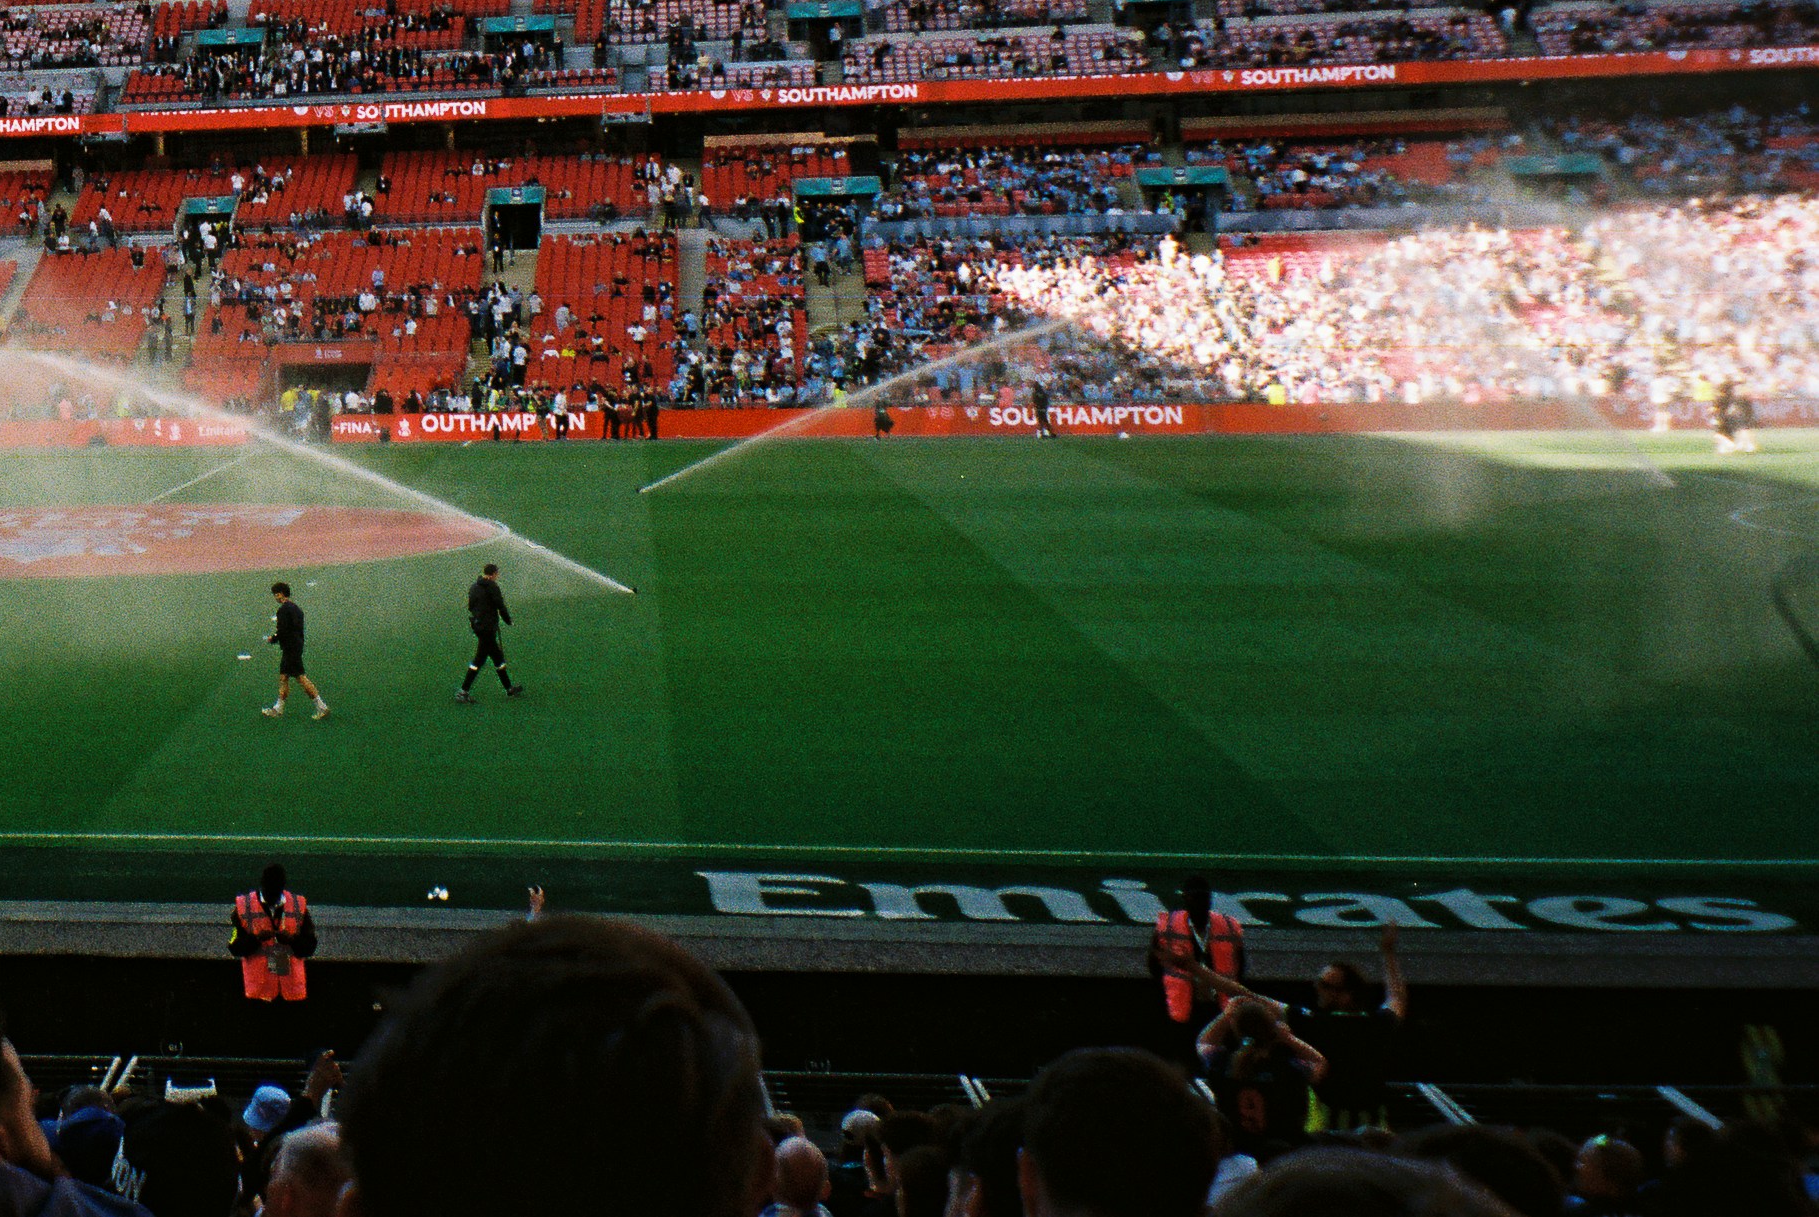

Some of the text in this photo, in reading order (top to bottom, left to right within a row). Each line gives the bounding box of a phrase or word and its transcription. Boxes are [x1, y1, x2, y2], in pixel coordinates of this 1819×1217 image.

[1241, 65, 1395, 85] SOUTHAMPTON
[778, 85, 917, 103] SOUTHAMPTON
[356, 101, 486, 119] SOUTHAMPTON
